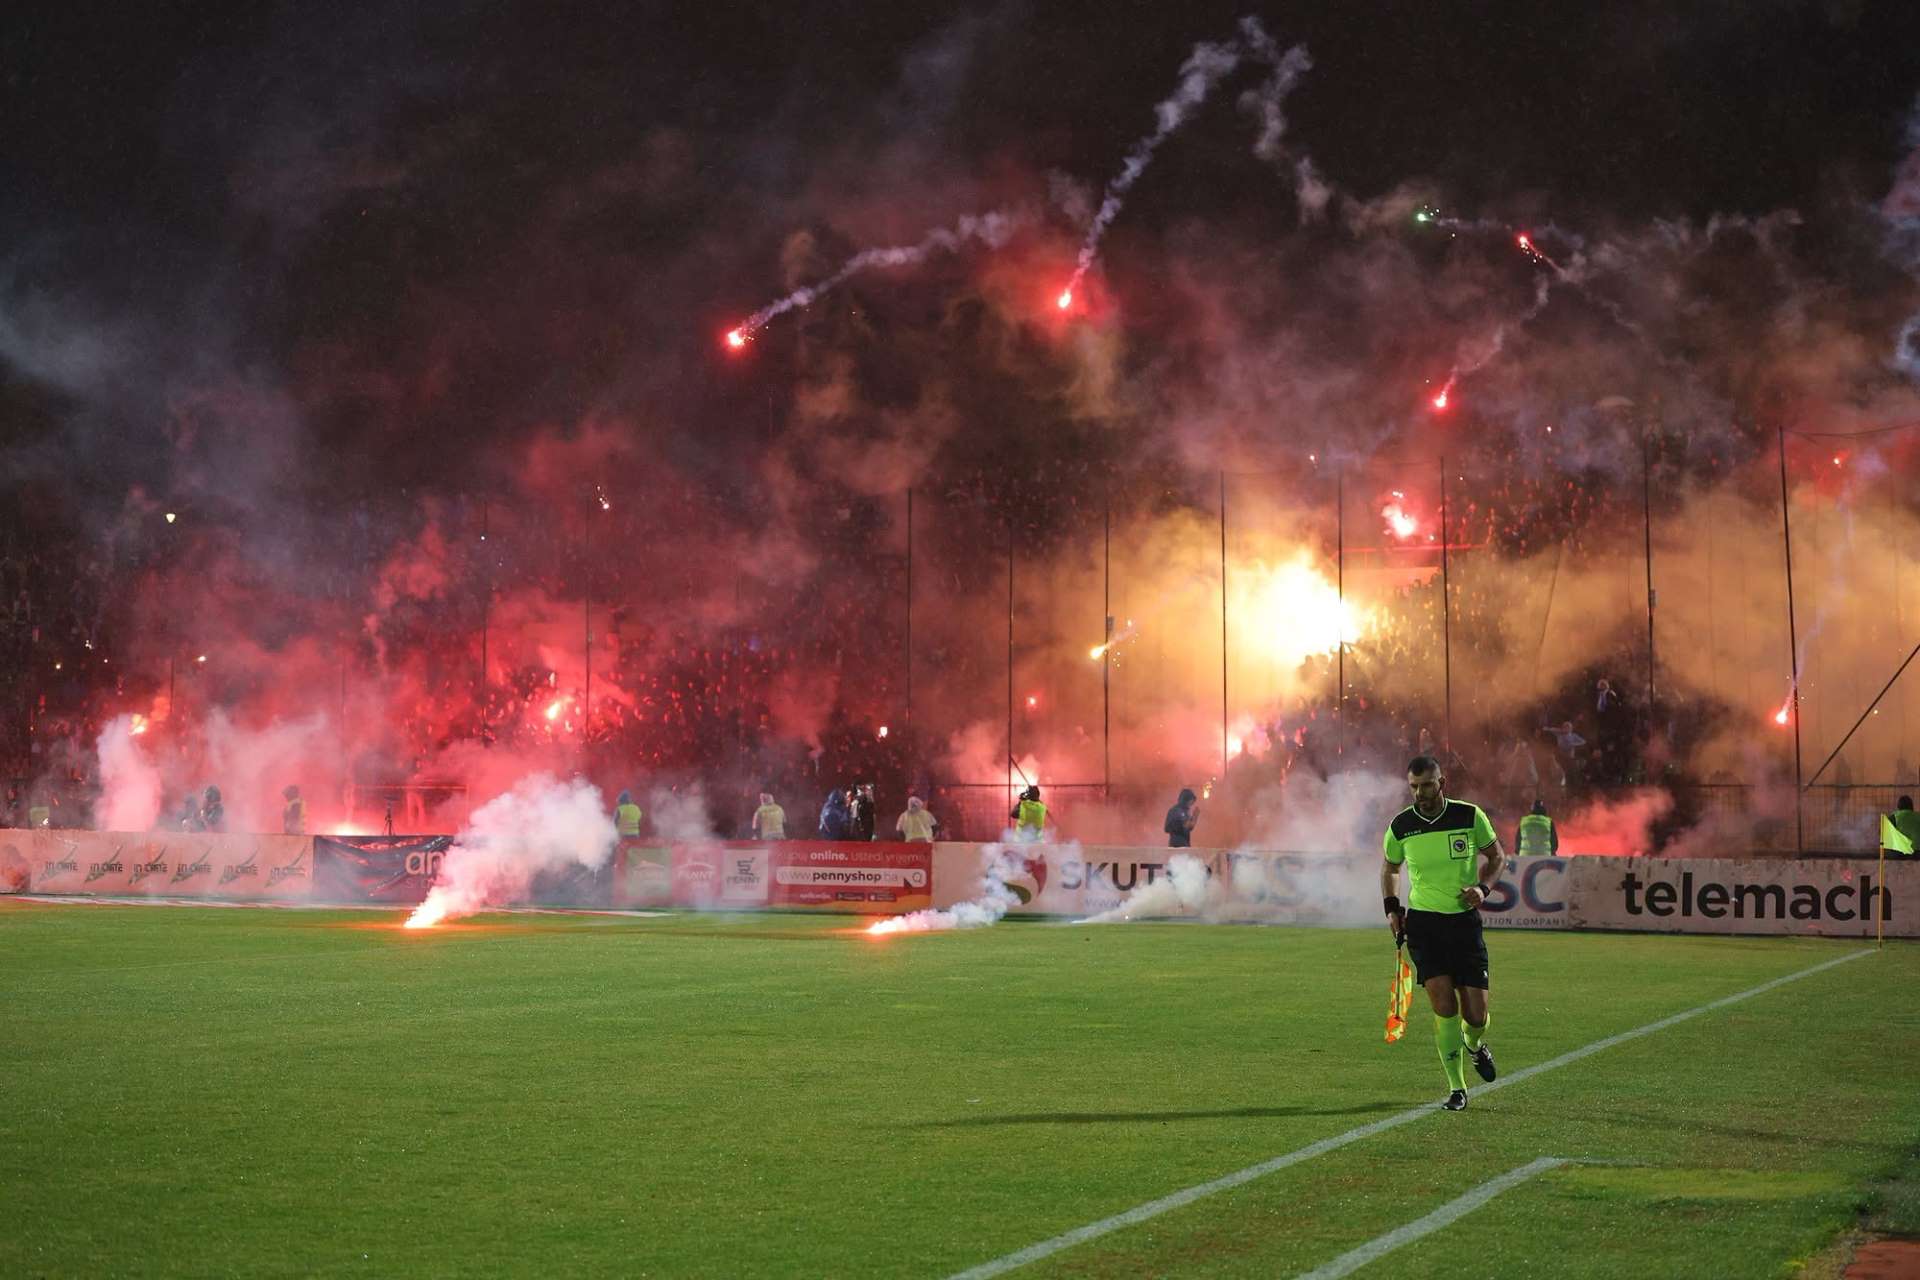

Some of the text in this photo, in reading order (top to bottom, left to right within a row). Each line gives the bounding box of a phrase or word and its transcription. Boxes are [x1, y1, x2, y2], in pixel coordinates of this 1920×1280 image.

[810, 850, 848, 861] online.
[1621, 871, 1893, 921] telemach
[1517, 918, 1566, 927] COMPANY
